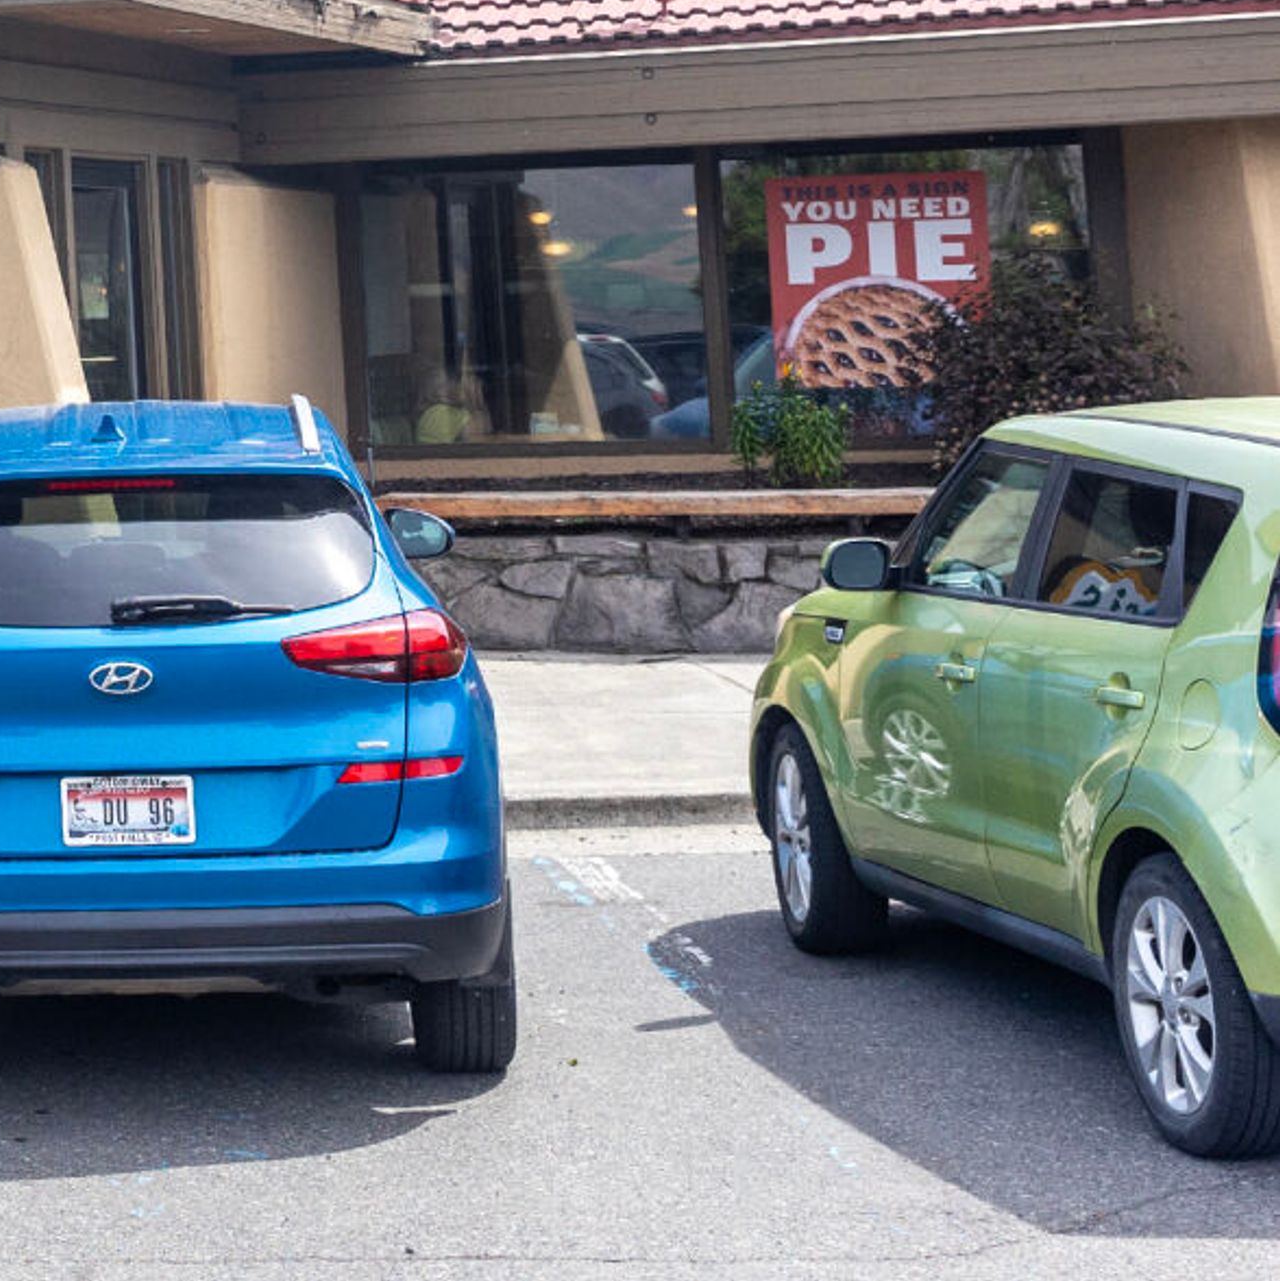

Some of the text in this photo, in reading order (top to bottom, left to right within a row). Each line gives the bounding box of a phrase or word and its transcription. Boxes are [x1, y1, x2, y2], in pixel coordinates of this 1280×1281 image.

[782, 180, 971, 200] THIS IS A SIGN
[781, 196, 971, 222] YOU NEED
[785, 219, 977, 285] PIE
[103, 797, 176, 826] DU 96
